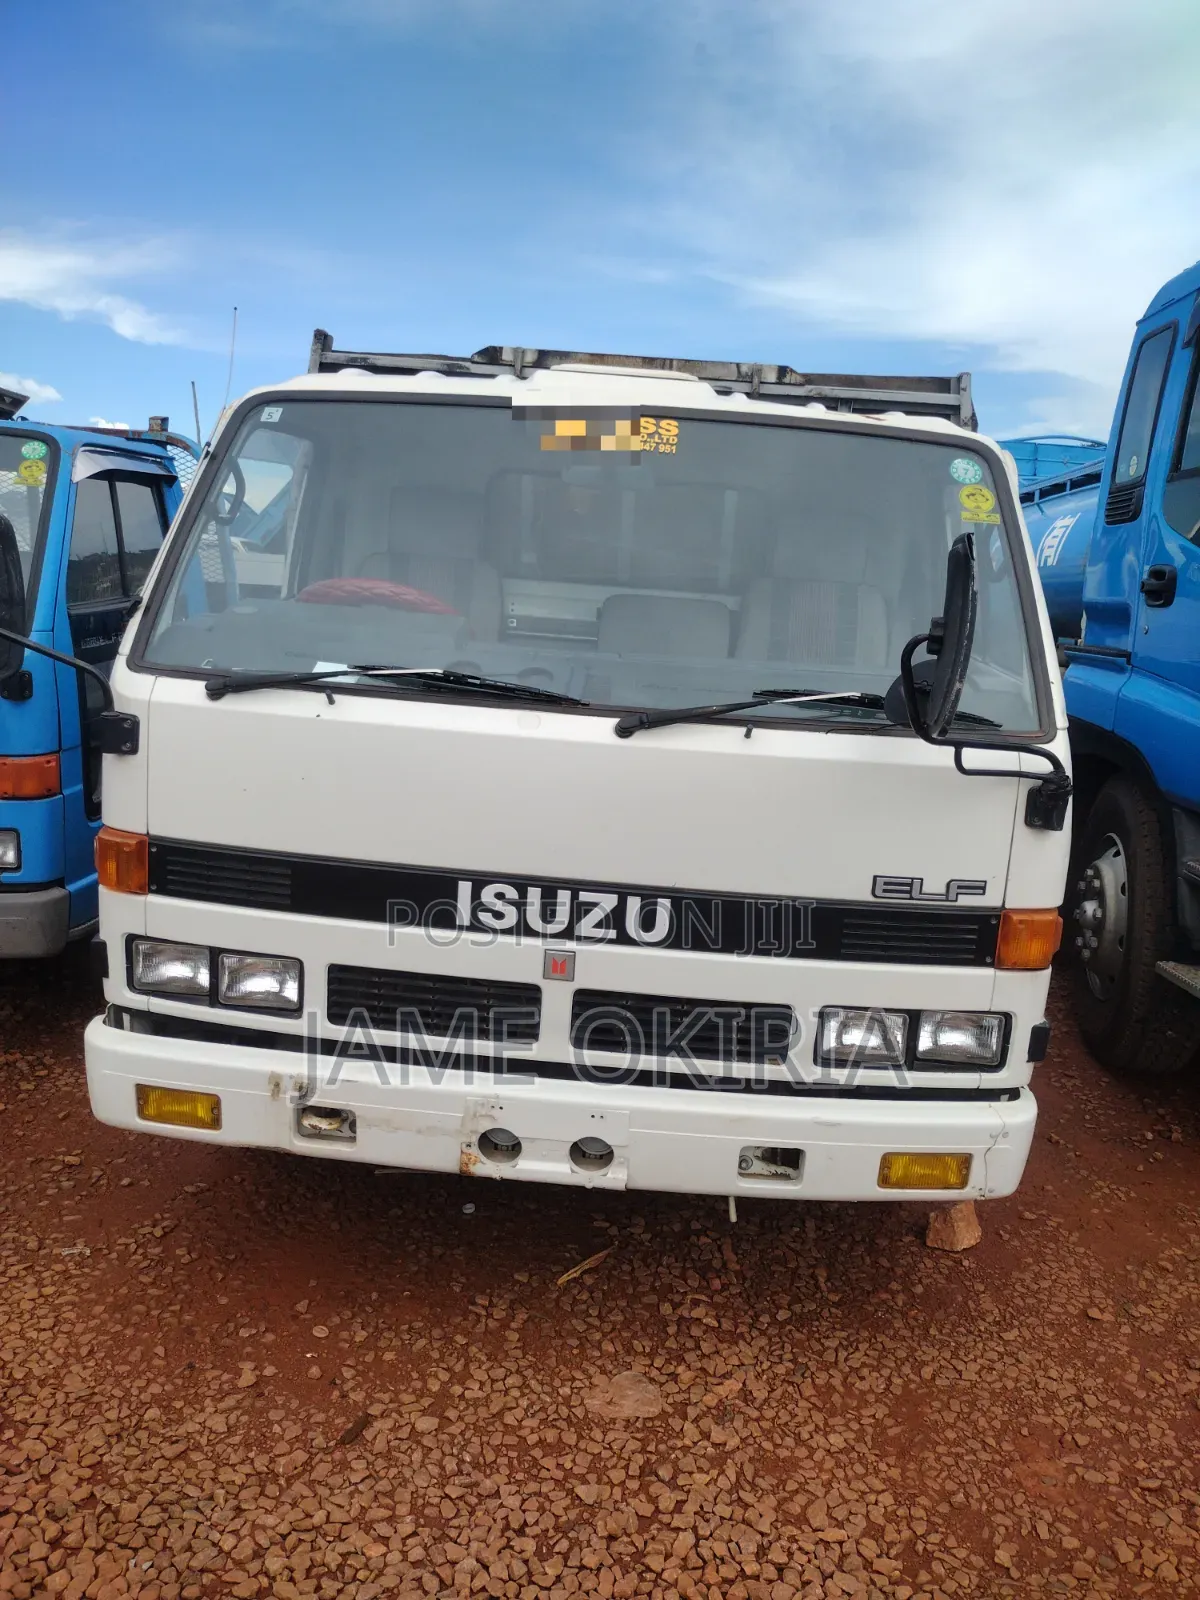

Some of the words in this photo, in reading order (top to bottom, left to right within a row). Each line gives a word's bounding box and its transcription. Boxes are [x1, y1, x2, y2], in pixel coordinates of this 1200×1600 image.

[658, 443, 676, 454] 951
[871, 875, 987, 902] ELF
[456, 880, 671, 943] ISUZU
